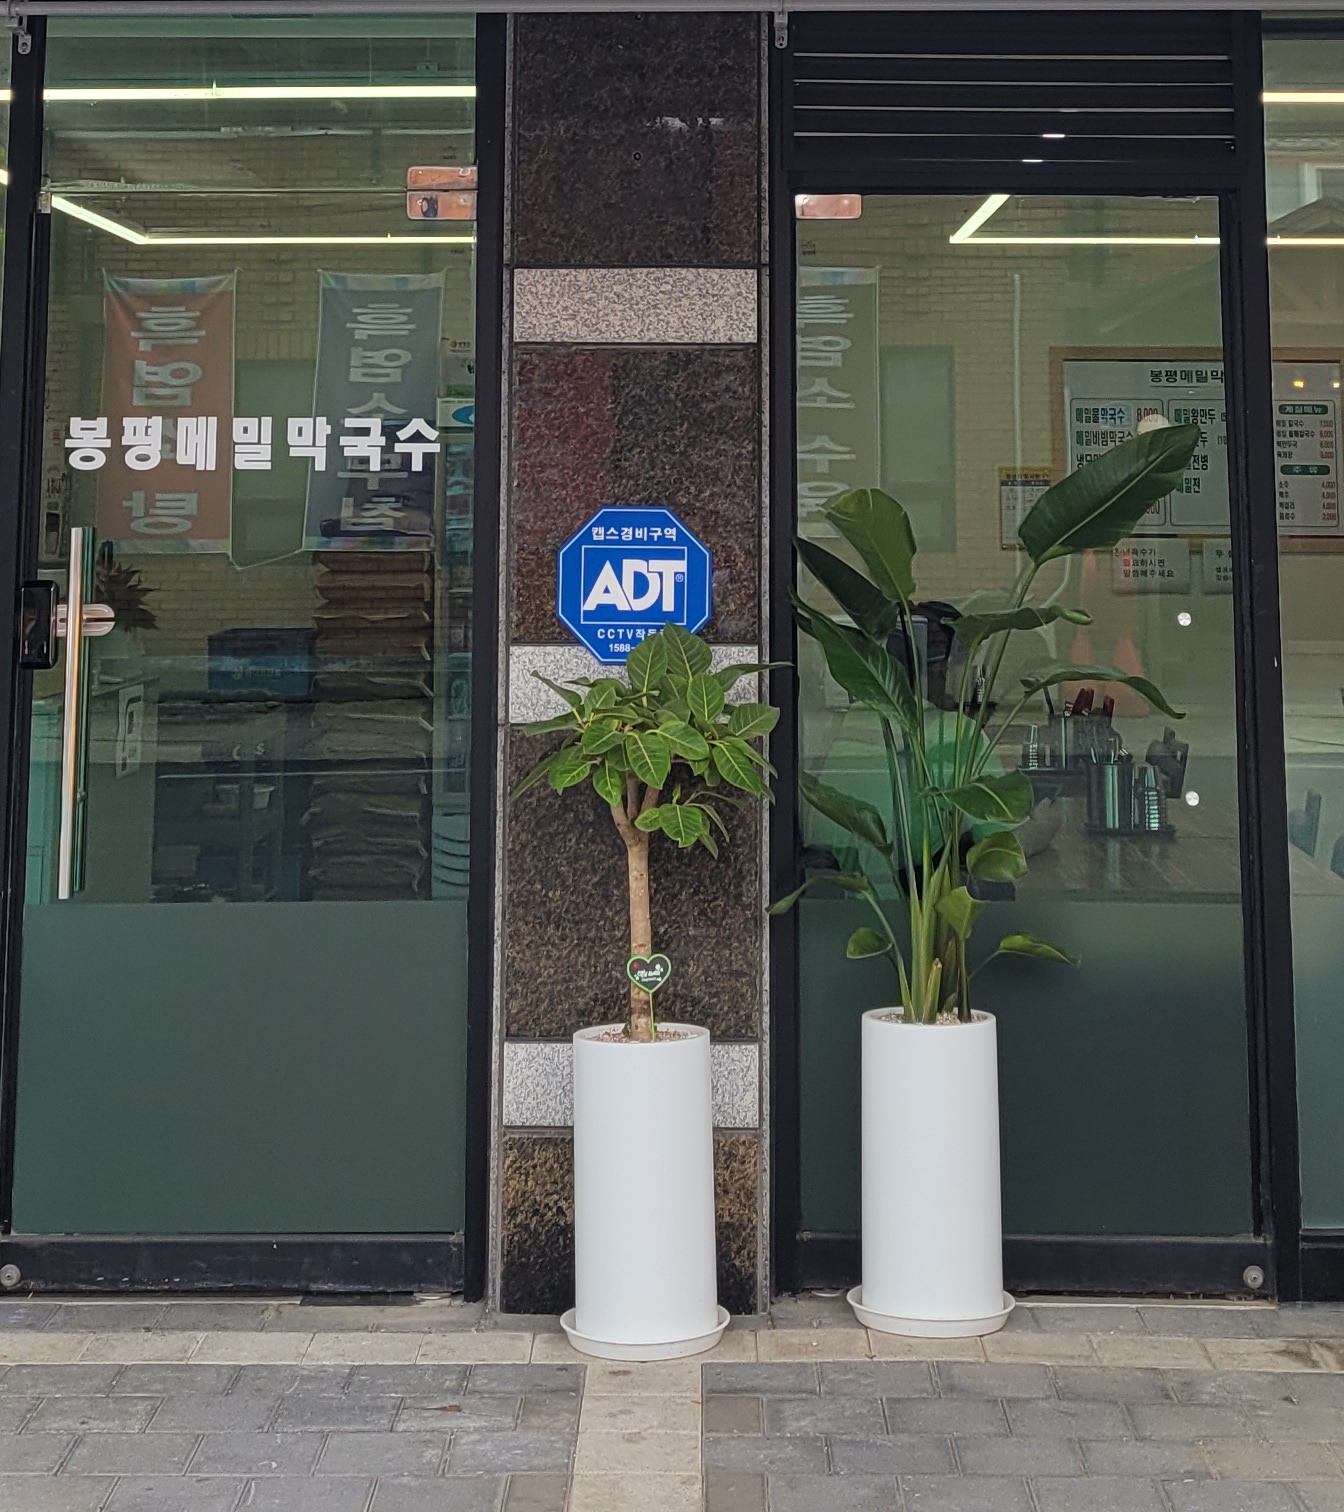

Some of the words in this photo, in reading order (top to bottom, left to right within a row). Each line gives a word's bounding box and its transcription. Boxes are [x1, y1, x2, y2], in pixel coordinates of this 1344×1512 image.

[1149, 369, 1224, 383] 봉평메밀막
[1075, 407, 1126, 424] 메밀물막국수
[1174, 408, 1216, 424] 메밀왕만두
[65, 416, 441, 472] 봉평메밀막국수
[591, 527, 677, 542] 캡스경비구역
[583, 559, 685, 612] ADT
[597, 628, 665, 641] CCTV작
